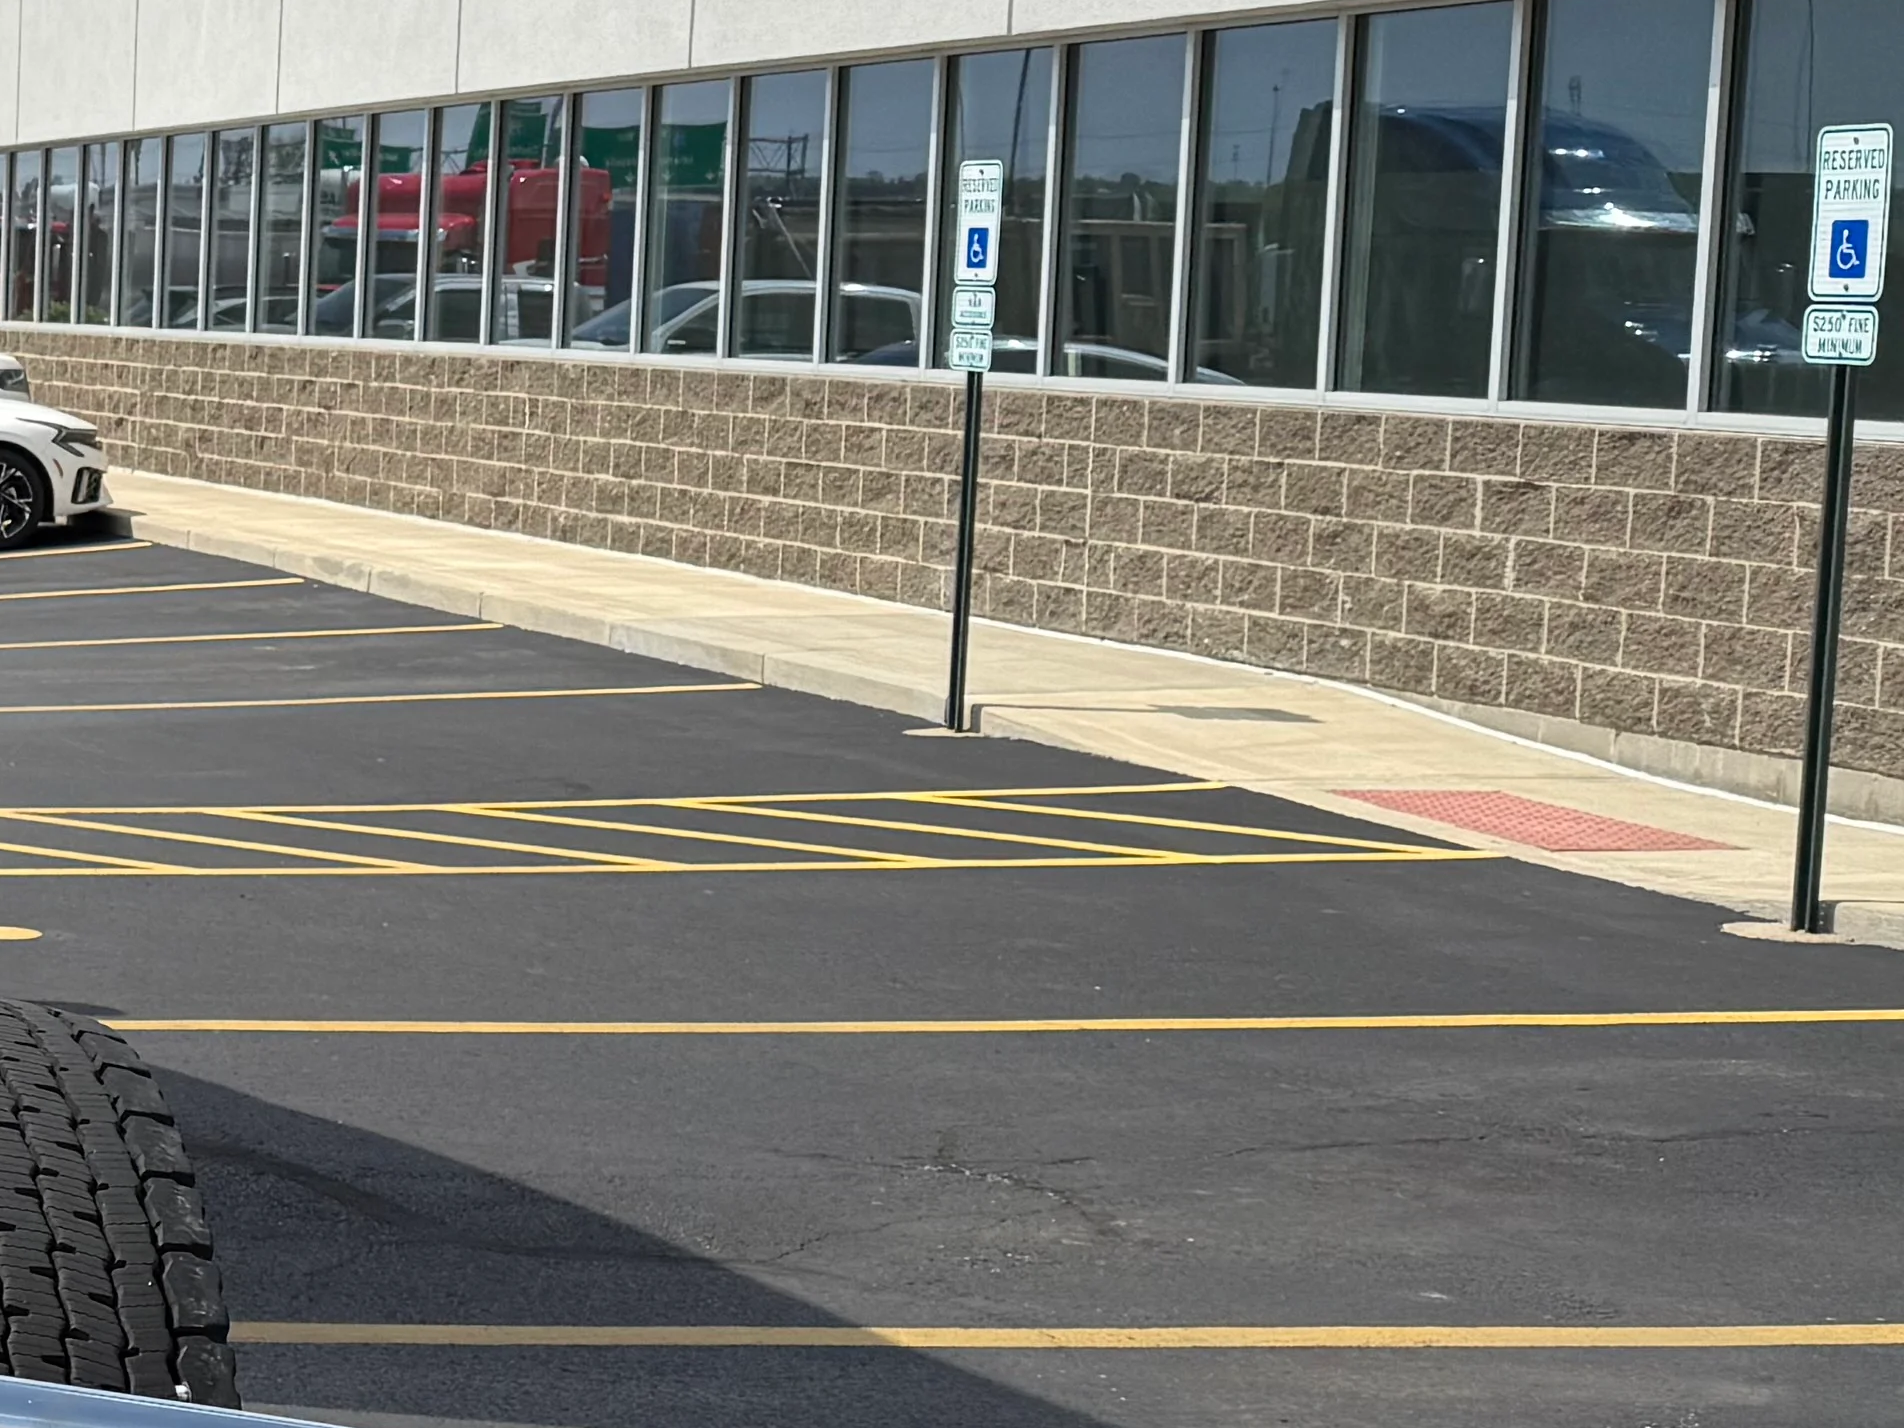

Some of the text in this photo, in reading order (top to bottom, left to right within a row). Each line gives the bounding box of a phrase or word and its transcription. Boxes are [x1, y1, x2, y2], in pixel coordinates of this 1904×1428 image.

[1822, 149, 1885, 170] RESERVED
[1824, 178, 1881, 201] PARKING
[1847, 317, 1871, 334] FINE
[1817, 337, 1863, 355] MINIMUM
